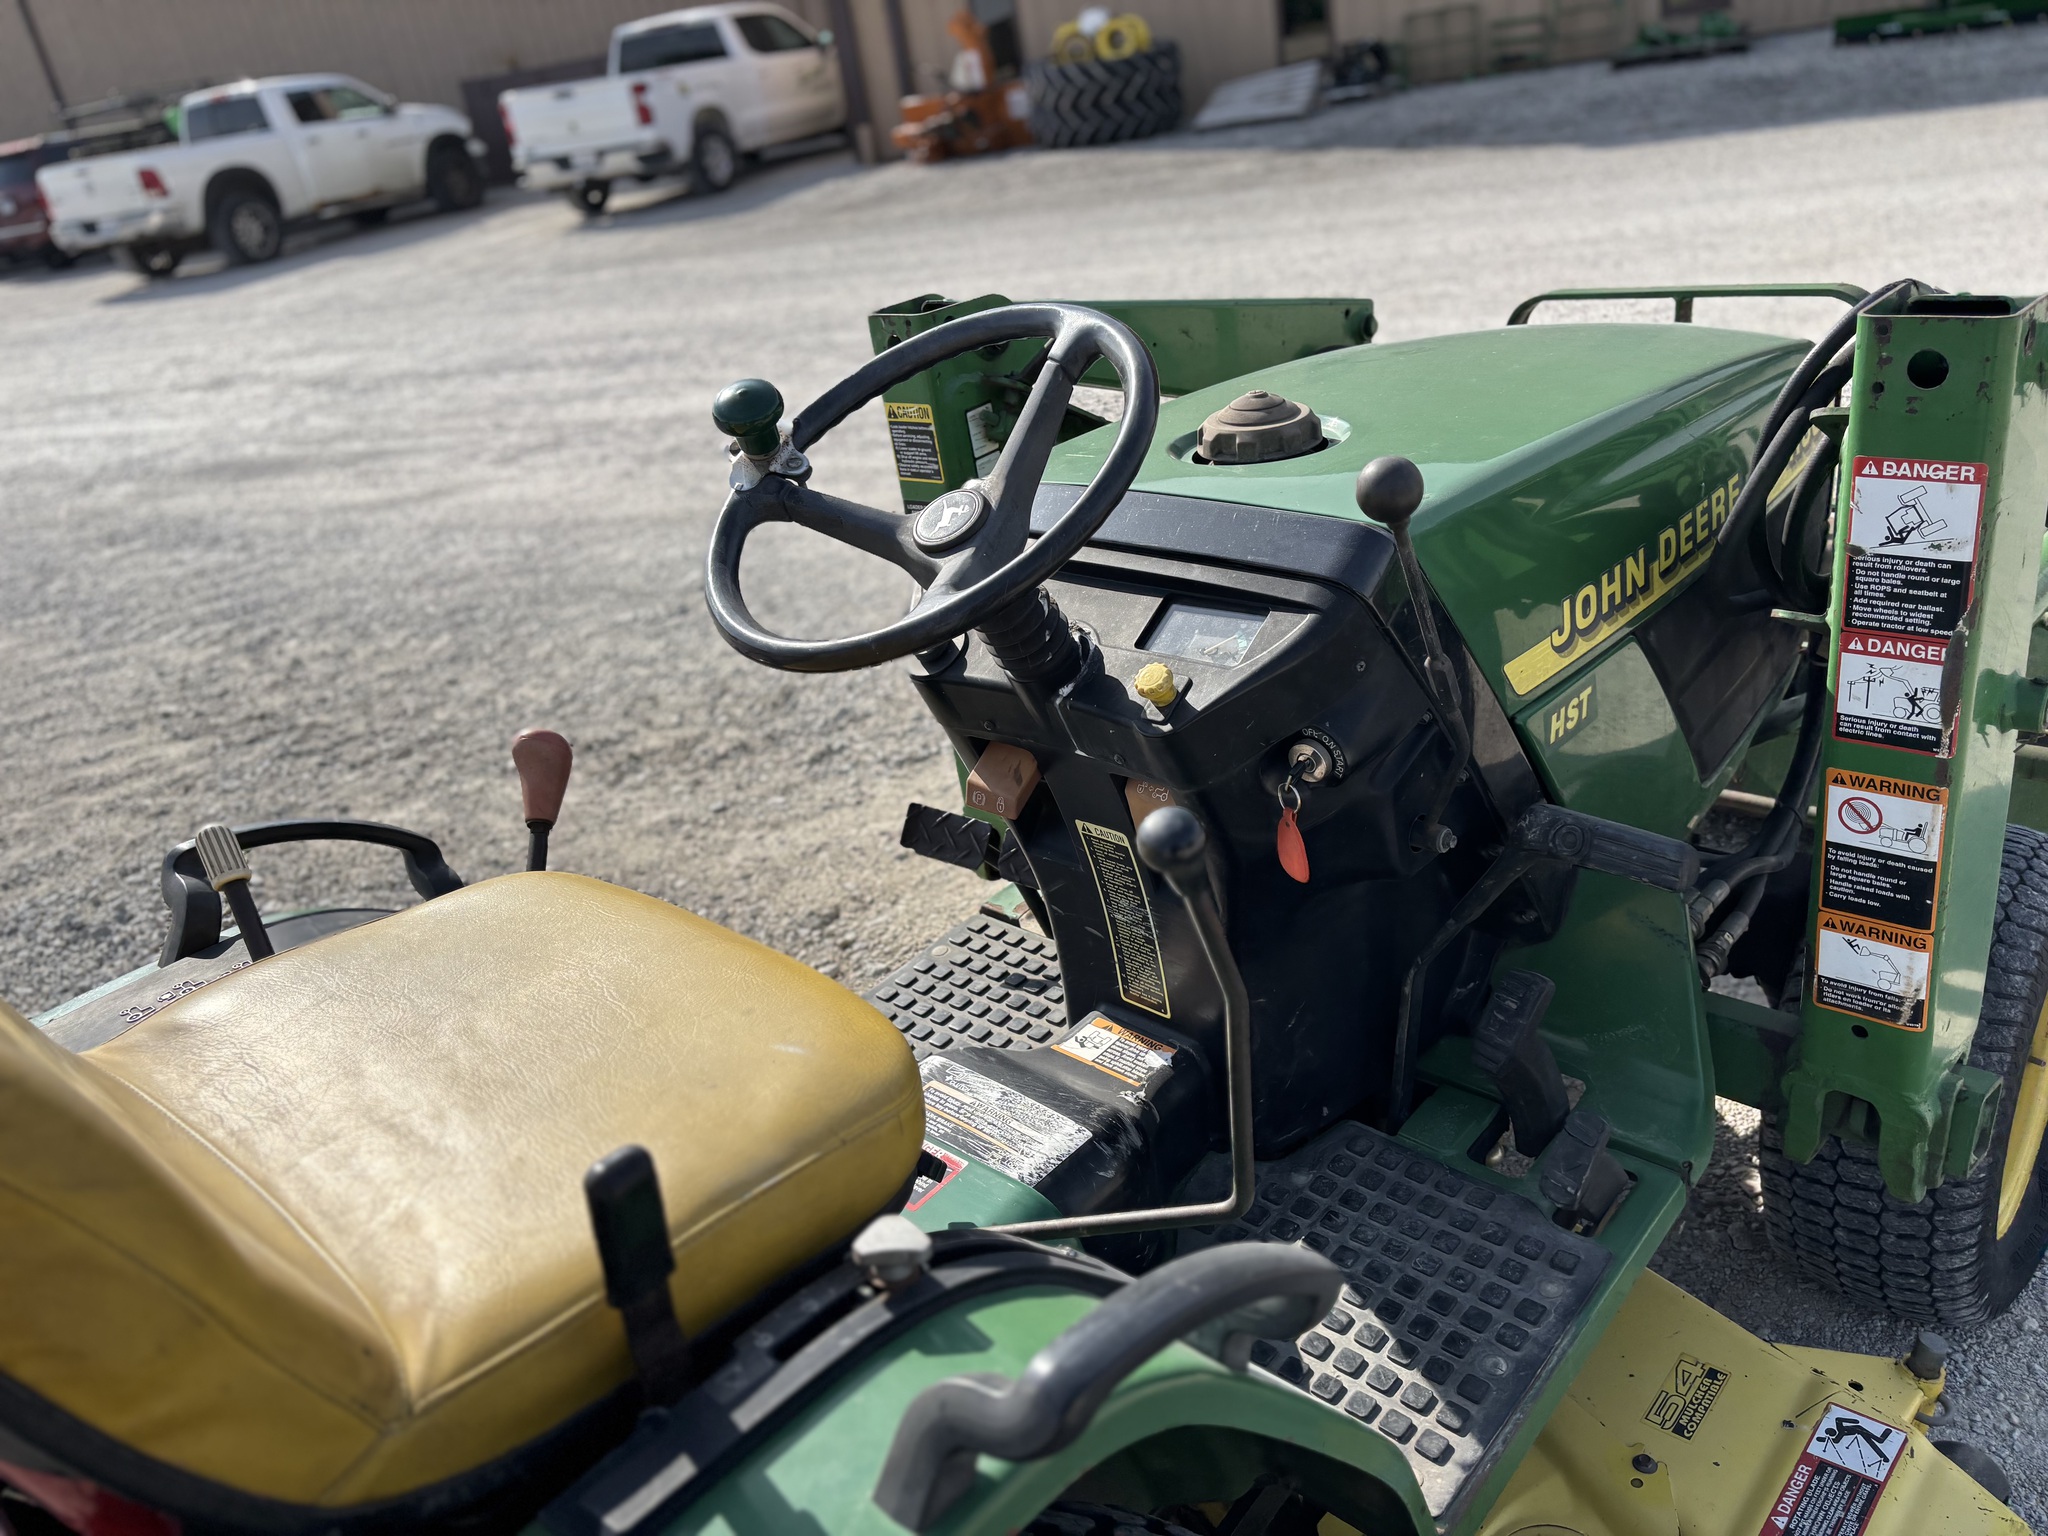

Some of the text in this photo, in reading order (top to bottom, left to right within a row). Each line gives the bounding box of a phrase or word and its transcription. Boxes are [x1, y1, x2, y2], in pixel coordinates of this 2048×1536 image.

[897, 406, 930, 419] CAUTION
[1882, 460, 1976, 482] DANGER
[1550, 472, 1742, 650] JOHN DEERE
[1882, 557, 1903, 566] injury
[1915, 560, 1936, 568] death
[1894, 565, 1928, 573] rollovers.
[1908, 574, 1930, 582] round
[1942, 577, 1961, 586] large
[1909, 589, 1938, 597] seatbelt
[1870, 599, 1899, 608] required
[1918, 603, 1944, 612] ballast.
[1874, 607, 1898, 615] wheels
[1910, 610, 1934, 619] widest
[1851, 619, 1880, 627] Operate
[1881, 621, 1905, 630] tractor
[1852, 612, 1931, 626] recommended setting.
[1868, 639, 1947, 661] DANGE
[1549, 685, 1593, 745] HST
[1840, 714, 1866, 724] Serious
[1868, 719, 1888, 729] injury
[1898, 724, 1918, 732] death
[1839, 727, 1884, 739] electric lines.
[1853, 723, 1873, 732] result
[1875, 726, 1892, 734] from
[1893, 729, 1919, 738] contact
[1322, 736, 1336, 749] ON
[1334, 750, 1344, 778] START
[1849, 774, 1940, 801] WARNING
[1094, 827, 1125, 844] CAUTION
[1837, 855, 1857, 865] falling
[1859, 859, 1880, 869] loads:
[1838, 849, 1856, 858] avoid
[1857, 852, 1876, 863] injury
[1887, 859, 1906, 868] death
[1908, 864, 1933, 874] caused
[1830, 871, 1892, 888] large square bales.
[1854, 870, 1876, 879] handle
[1877, 874, 1898, 884] round
[1829, 885, 1855, 895] caution.
[1830, 879, 1910, 901] Handle raised loads with
[1829, 891, 1881, 907] Carry loads low.
[1840, 920, 1927, 950] WARNING
[1830, 980, 1847, 989] avoid
[1849, 984, 1867, 994] injury
[1869, 989, 1884, 998] from
[1823, 991, 1842, 1000] riders
[1853, 999, 1873, 1008] loader
[1823, 997, 1864, 1012] attachments.
[1846, 992, 1861, 1000] work
[1863, 996, 1878, 1005] from
[1118, 1029, 1163, 1050] WARNING
[977, 1102, 1011, 1124] WARNING
[1645, 1358, 1706, 1430] 54
[1679, 1378, 1712, 1426] MULCHER
[1684, 1372, 1726, 1437] COMPATIBLE
[1776, 1462, 1812, 1514] DANGER
[1821, 1480, 1841, 1510] OBJECTS
[1788, 1474, 1821, 1529] ROTATING BLADE
